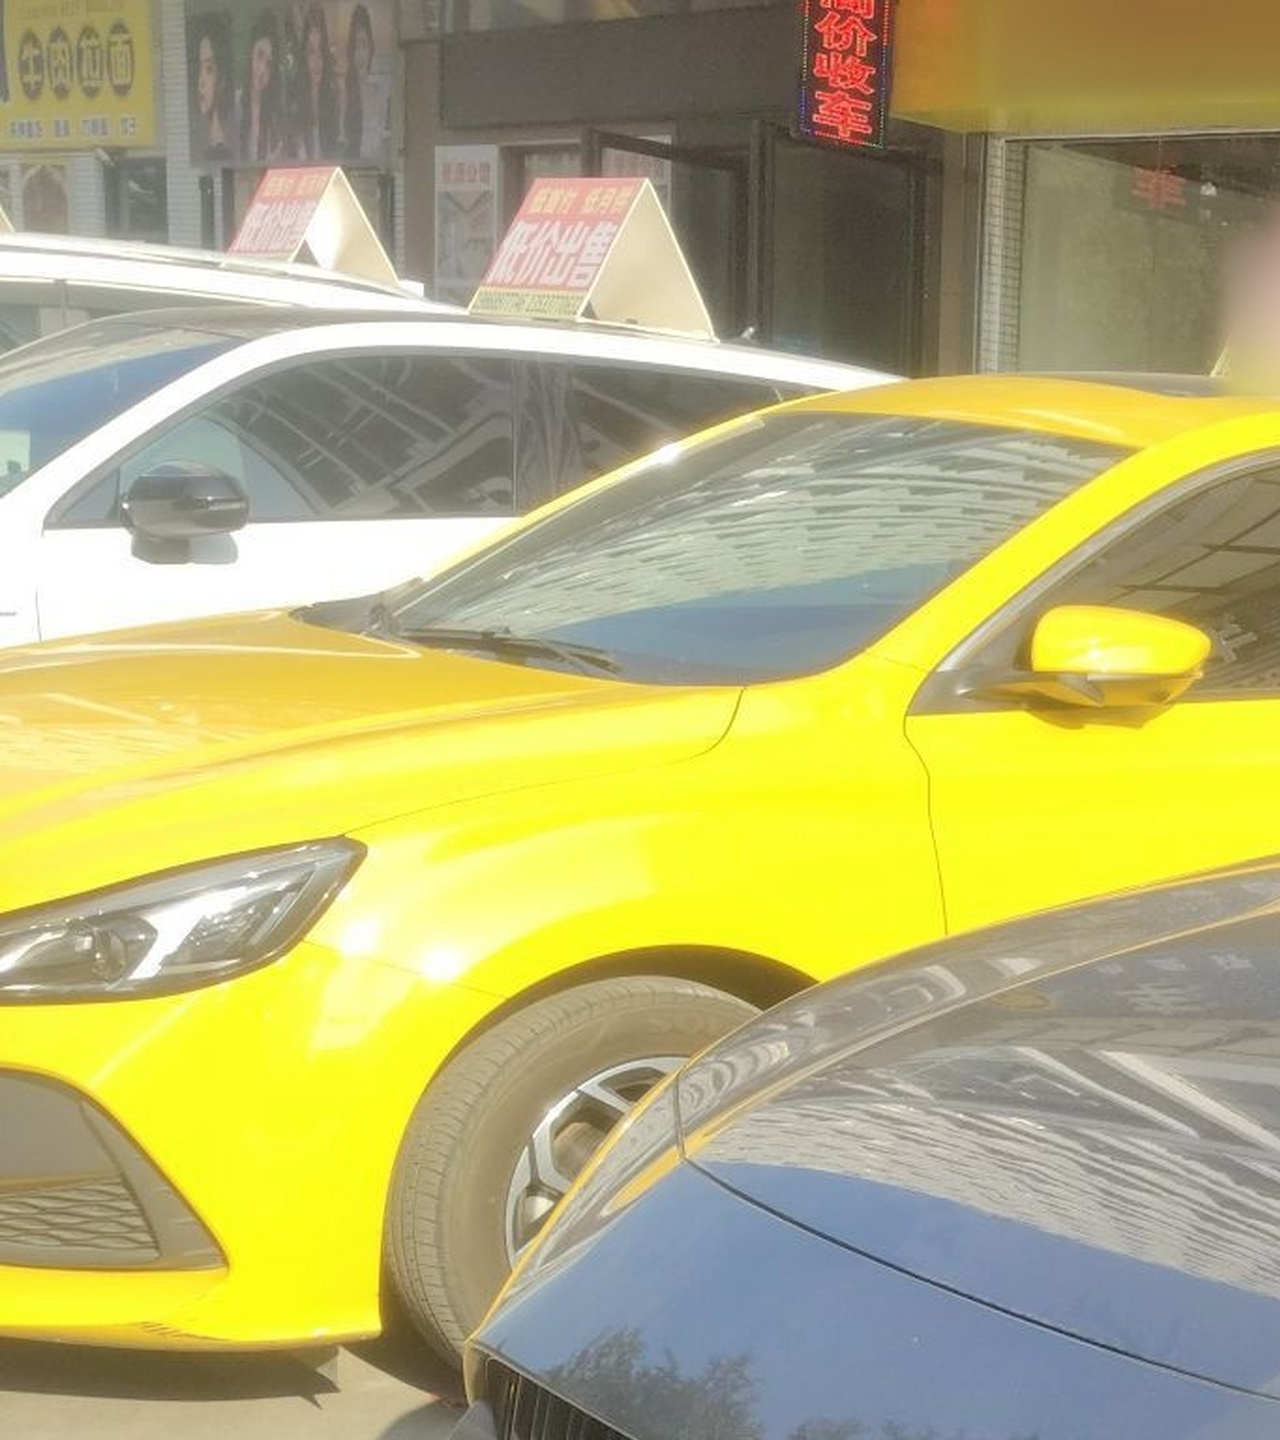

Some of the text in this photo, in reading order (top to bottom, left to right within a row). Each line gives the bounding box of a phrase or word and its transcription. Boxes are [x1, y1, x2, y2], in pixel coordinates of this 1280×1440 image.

[19, 27, 134, 99] 牛肉拉面
[484, 220, 619, 287] 低价出售
